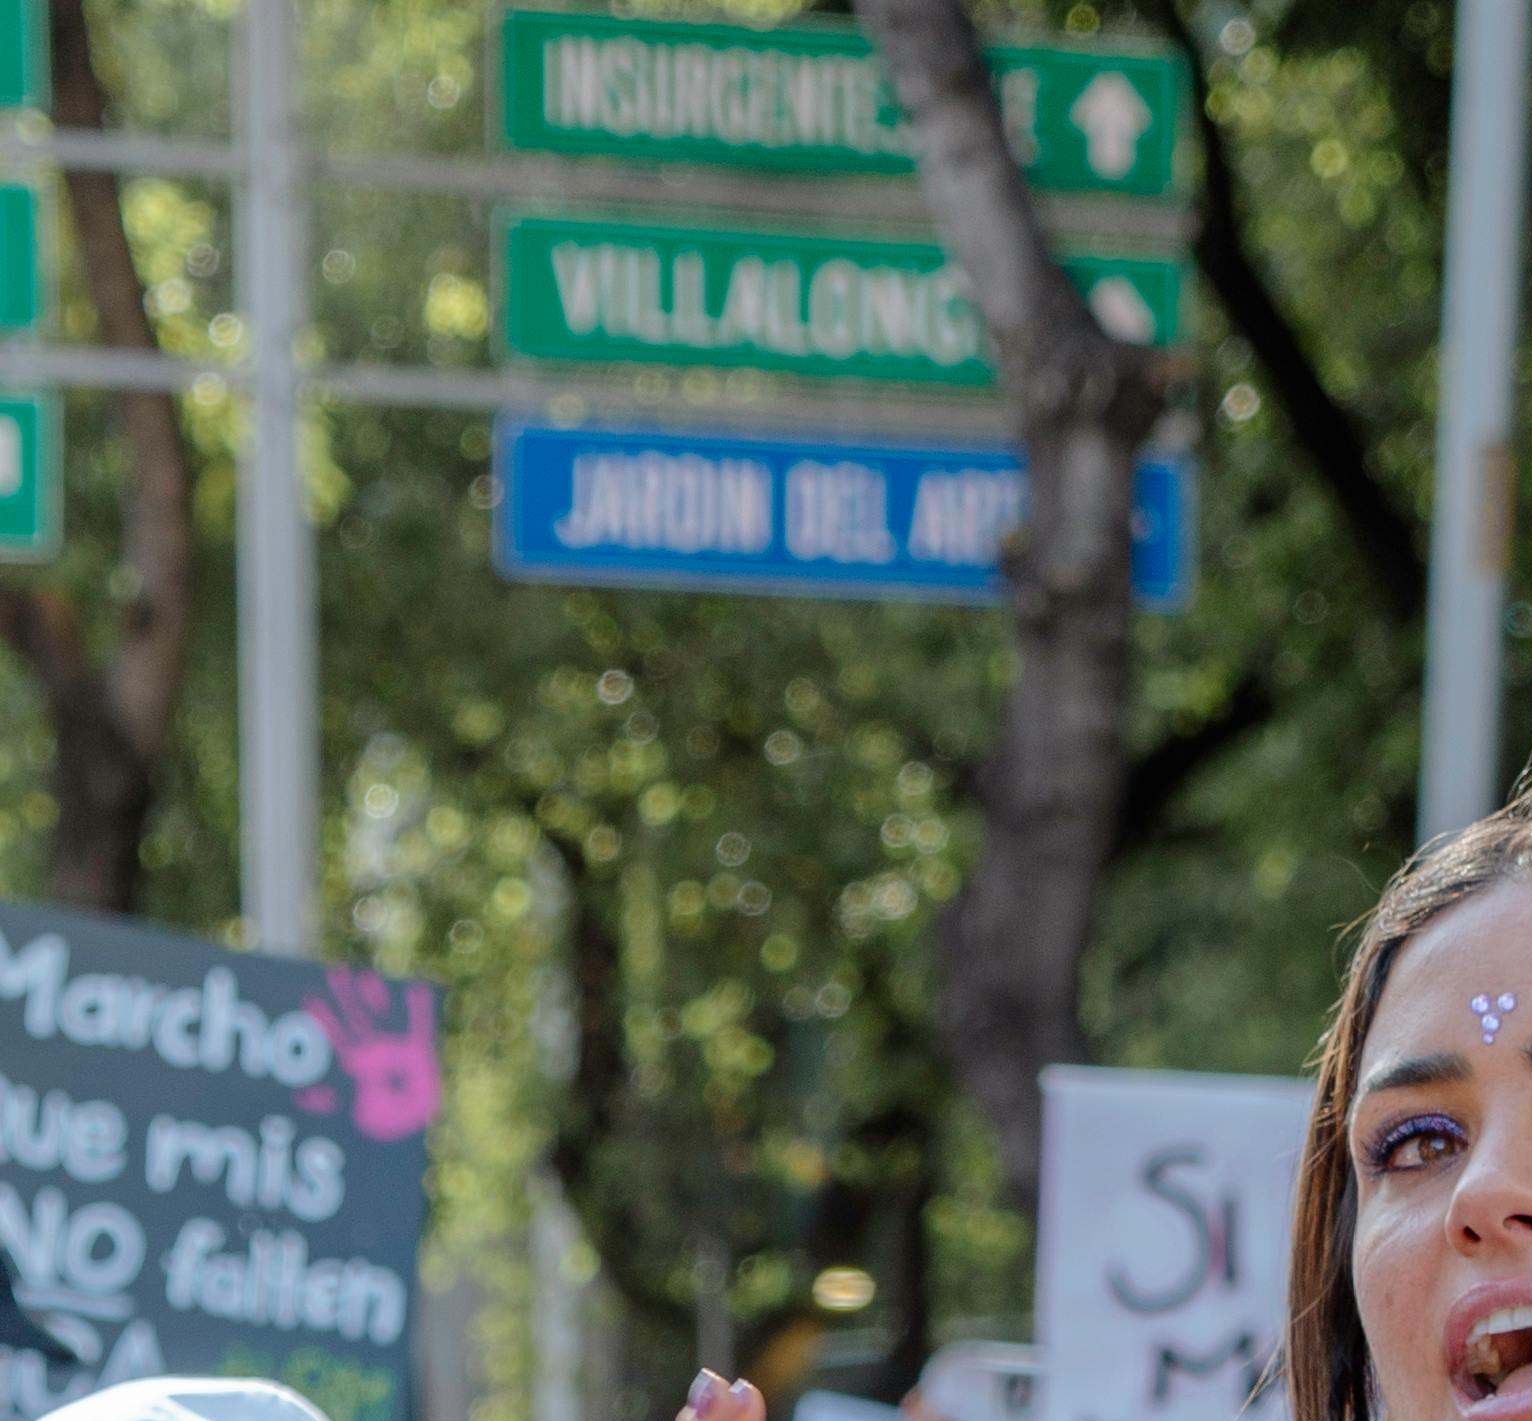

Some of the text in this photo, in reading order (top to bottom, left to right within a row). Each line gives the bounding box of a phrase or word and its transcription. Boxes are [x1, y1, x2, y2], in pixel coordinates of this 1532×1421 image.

[551, 240, 982, 366] VILLALONG
[785, 459, 897, 565] DEL
[145, 1114, 346, 1222] mis
